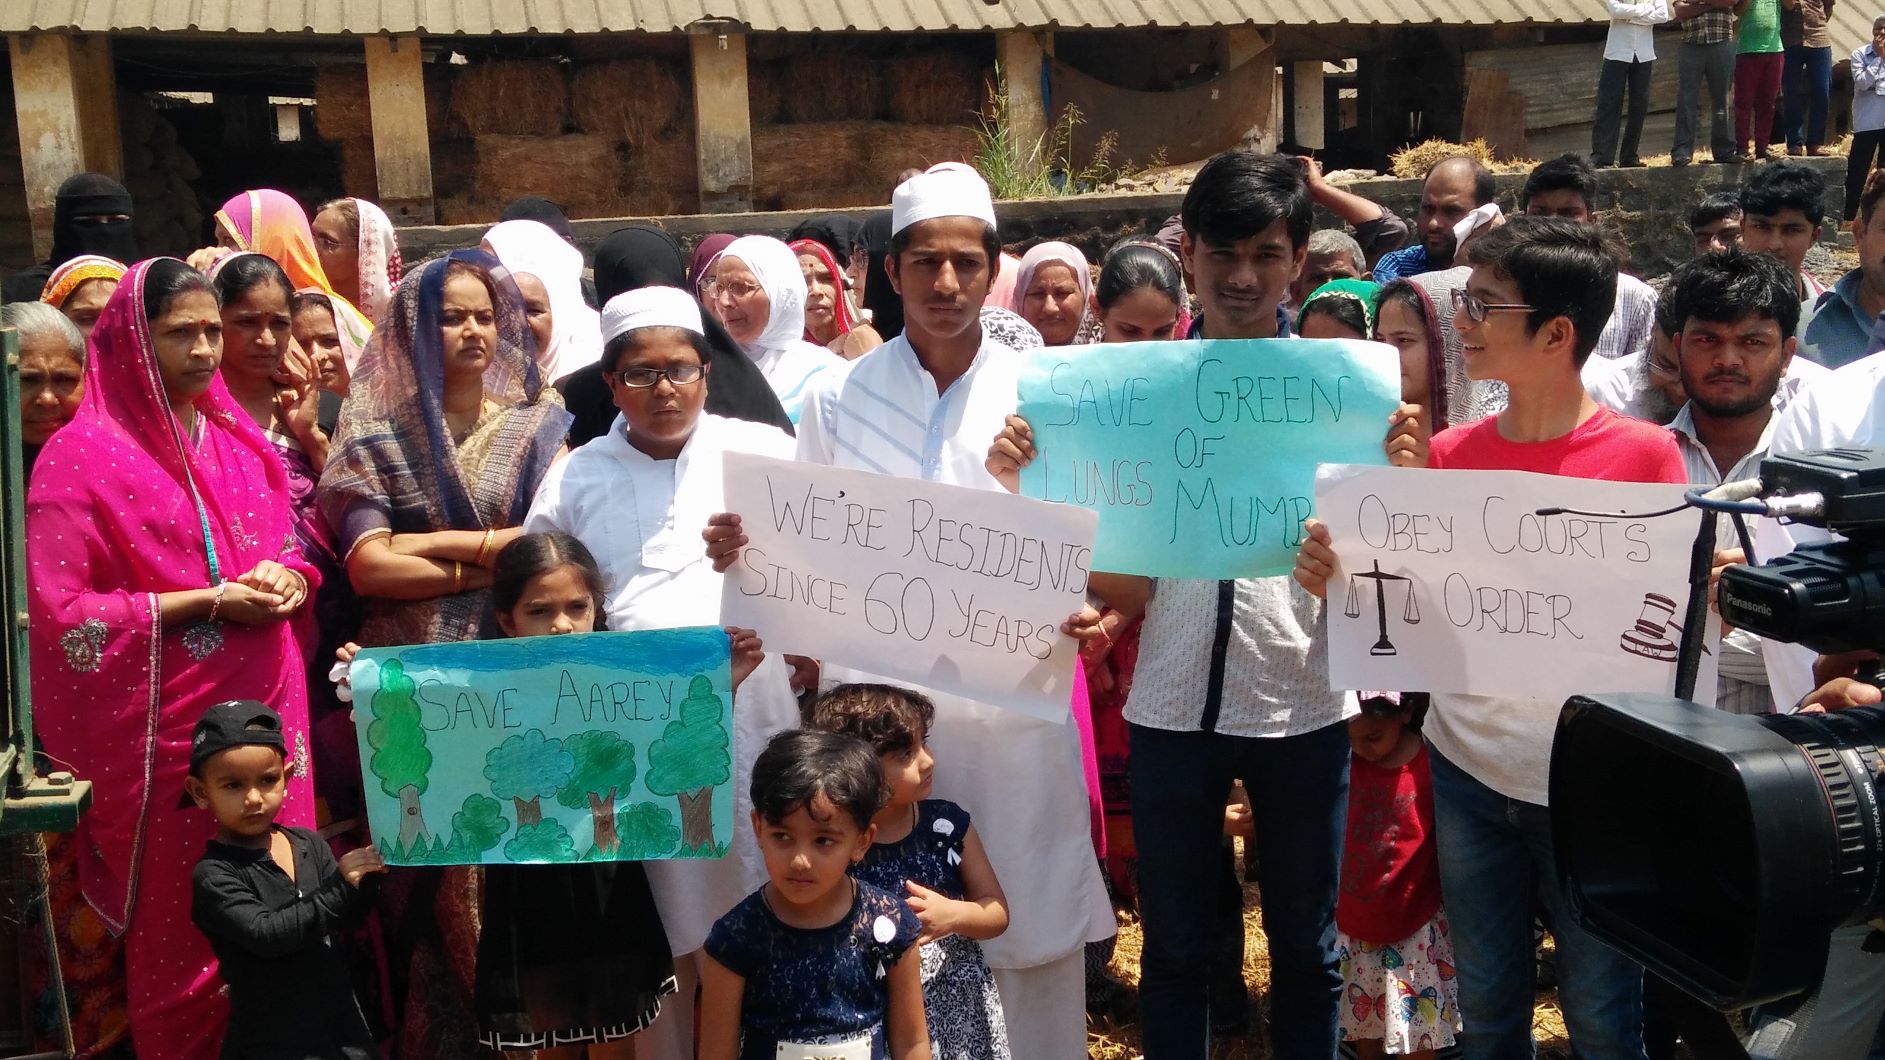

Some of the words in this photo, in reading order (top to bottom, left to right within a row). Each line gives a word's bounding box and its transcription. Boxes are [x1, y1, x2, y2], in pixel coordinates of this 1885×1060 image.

[1045, 362, 1153, 426] SAVE
[1196, 358, 1351, 424] GREEN
[1175, 427, 1225, 468] OF
[1043, 449, 1154, 507] LUNGS
[767, 475, 887, 551] WE'RE
[902, 498, 1090, 593] RESIDENTS
[1358, 494, 1453, 553] OBEY
[740, 547, 847, 615] SINCE
[864, 572, 935, 641] 60
[948, 589, 1055, 660] YEARS
[1443, 572, 1584, 640] ORDER
[1727, 593, 1772, 616] Panasonic
[418, 678, 522, 731] SAVE
[552, 670, 674, 725] AAREY
[1863, 781, 1877, 805] ZOOM
[1872, 805, 1883, 839] OPTICAL
